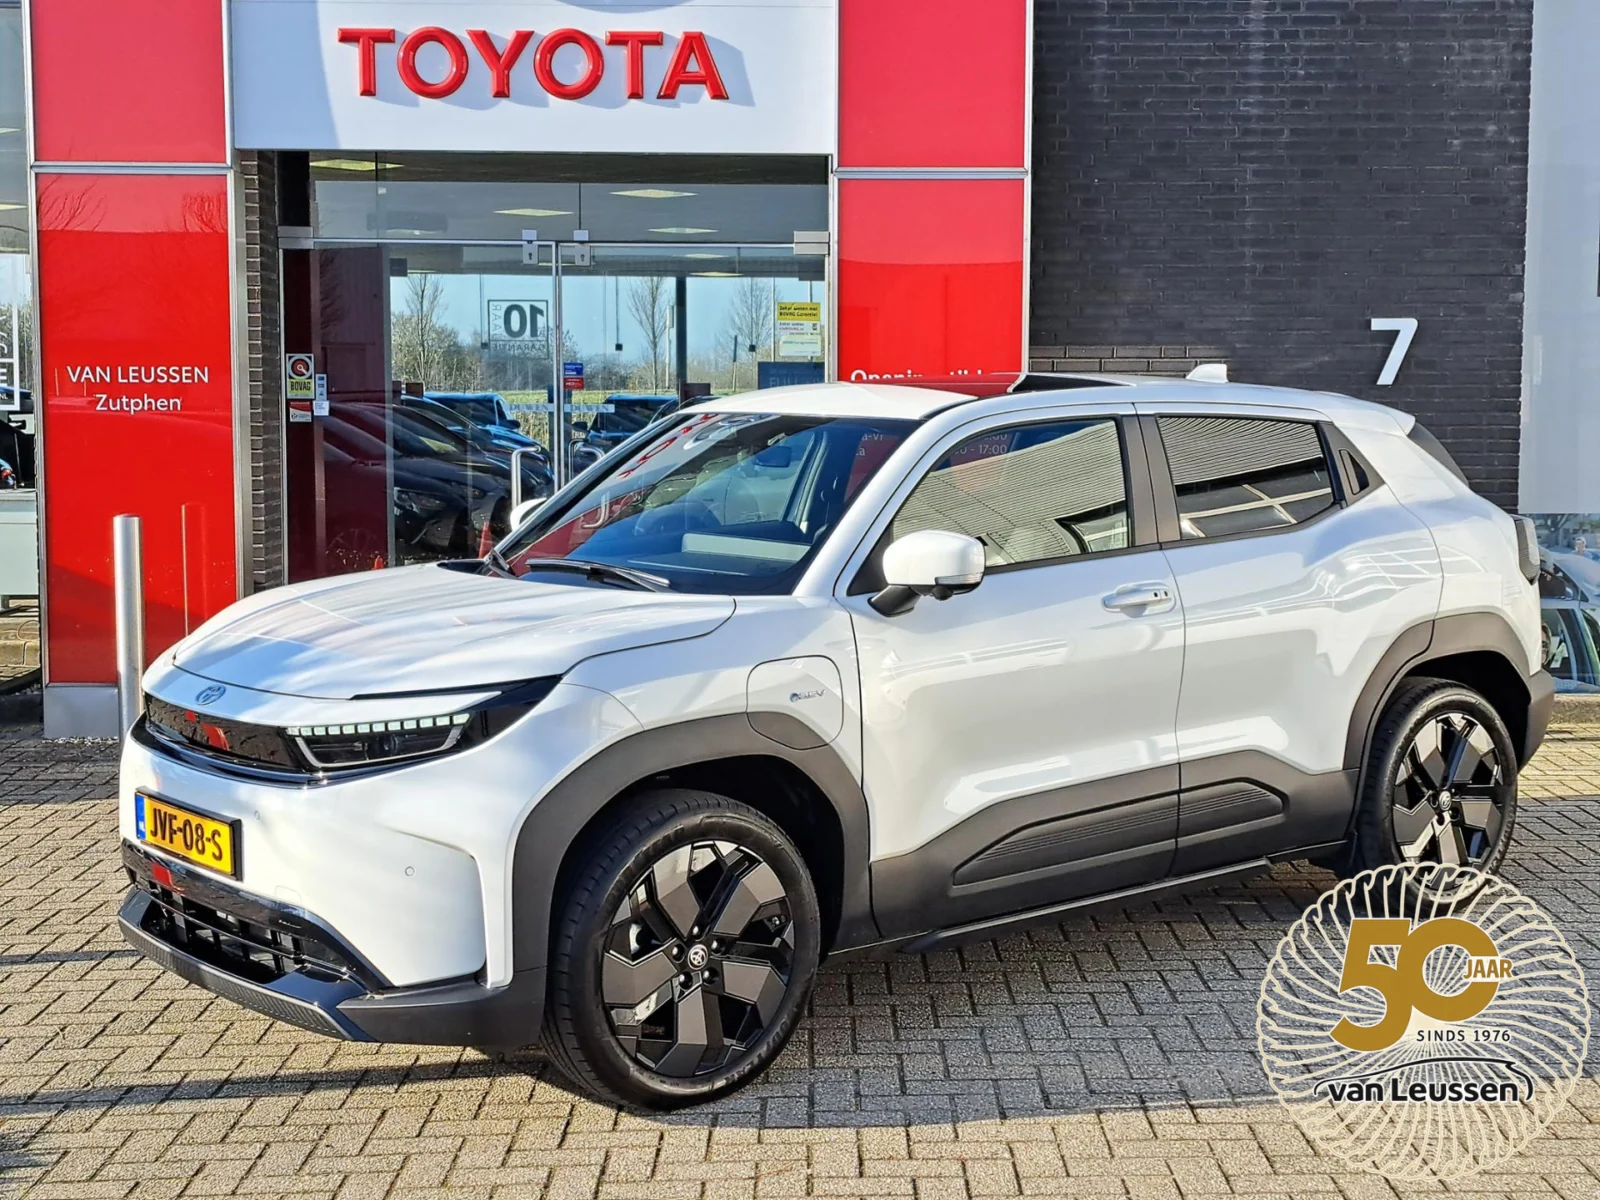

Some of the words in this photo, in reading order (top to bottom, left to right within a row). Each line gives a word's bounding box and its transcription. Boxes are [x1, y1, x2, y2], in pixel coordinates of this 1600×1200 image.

[337, 26, 729, 100] TOYOTA
[1371, 317, 1418, 386] 7
[66, 366, 111, 383] VAN
[117, 366, 209, 383] LEUSSEN
[290, 380, 311, 391] BOVAG
[95, 393, 182, 415] Zutphen
[978, 444, 1008, 455] 17:00
[150, 808, 223, 862] JVF-08-S
